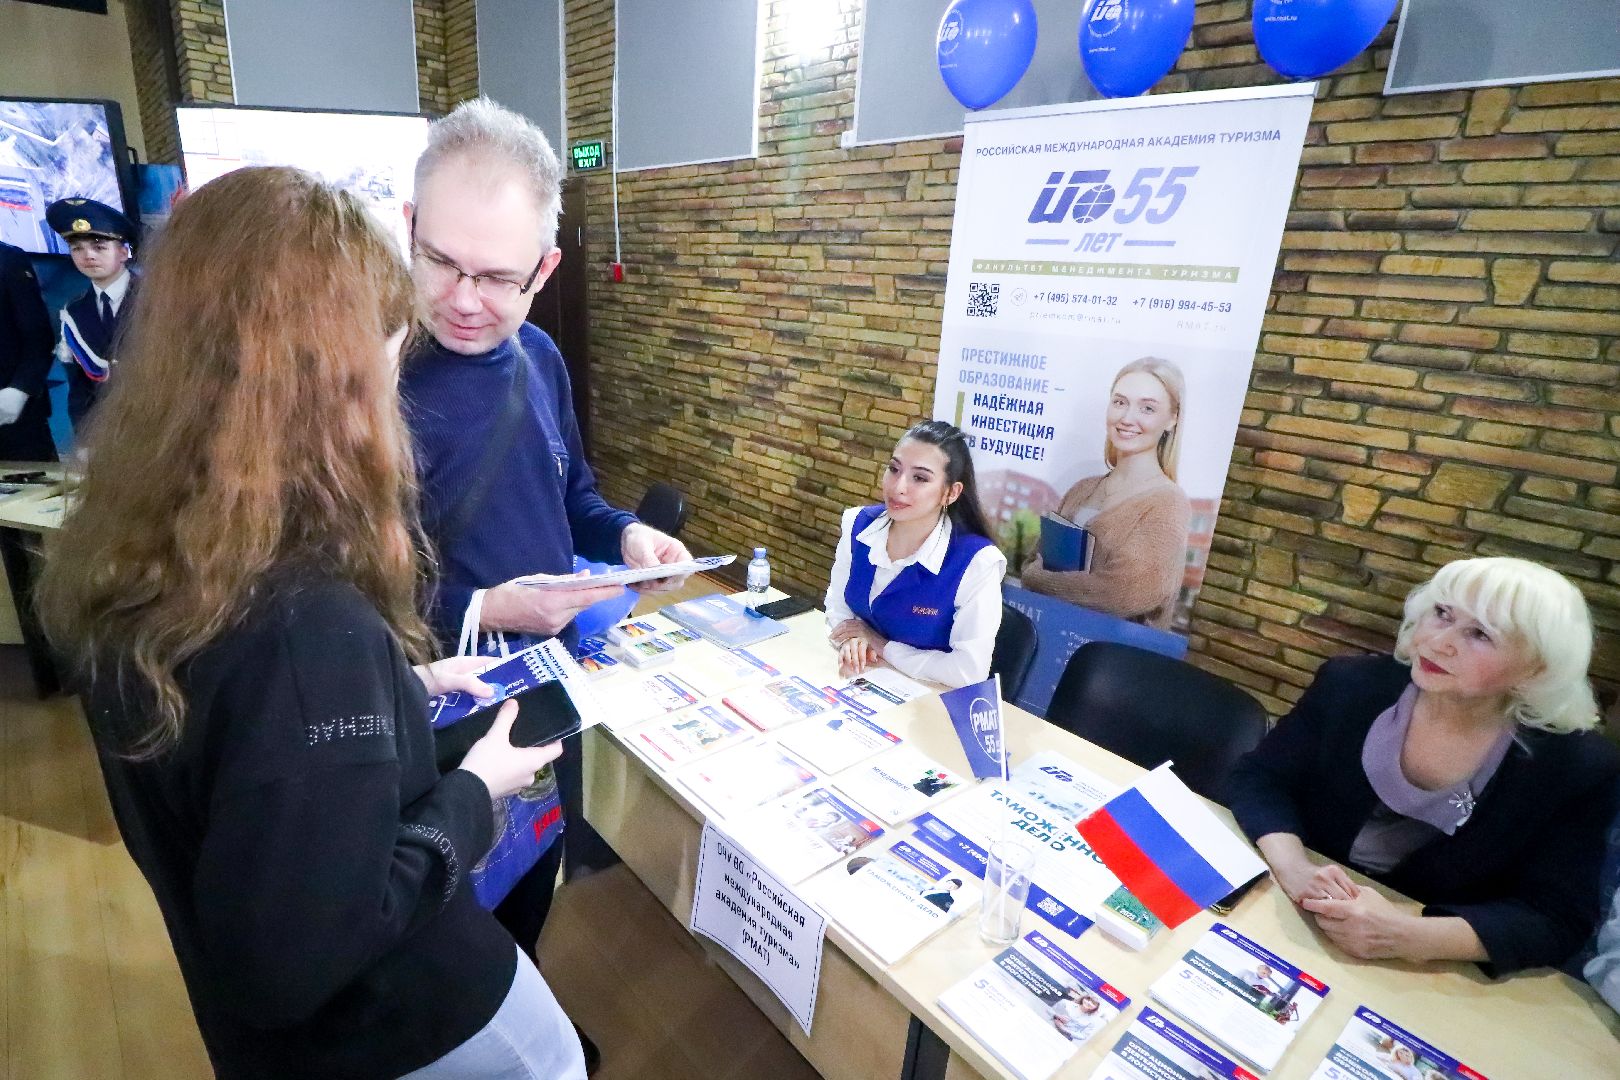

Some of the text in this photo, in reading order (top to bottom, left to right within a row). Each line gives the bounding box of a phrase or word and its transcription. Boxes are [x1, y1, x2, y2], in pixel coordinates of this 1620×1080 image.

[573, 145, 601, 159] ВЫХОД
[976, 129, 1282, 157] РОССИЙСКАЯ МЕЖДУНАРОДНАЯ АКАДЕМИЯ ТУРИЗМА
[577, 157, 597, 168] EXIT
[1113, 166, 1200, 224] 55
[1073, 232, 1123, 253] лет
[1051, 264, 1152, 276] МЕНЕДЖМЕНТА
[1162, 269, 1233, 280] ТУРИЗМА
[1033, 292, 1118, 306] +7 (495) 574-01-32
[1132, 297, 1146, 308] +7
[1149, 297, 1175, 311] (916)
[961, 347, 1048, 370] ПРЕСТИЖНОЕ
[959, 369, 1049, 394] ОБРАЗОВАНИЕ
[973, 393, 1044, 416] НАДЁЖНАЯ
[971, 414, 1055, 441] ИНВЕСТИЦИЯ
[968, 435, 1045, 461] В БУДУЩЕЕ!
[984, 734, 996, 754] 55
[990, 789, 1105, 865] ТАМОЖННО
[1010, 819, 1066, 852] ДЕЛО
[733, 855, 745, 875] ВО
[715, 889, 757, 931] академия
[724, 873, 793, 941] международная
[742, 928, 770, 966] (РМАТ)
[1179, 969, 1194, 980] 5
